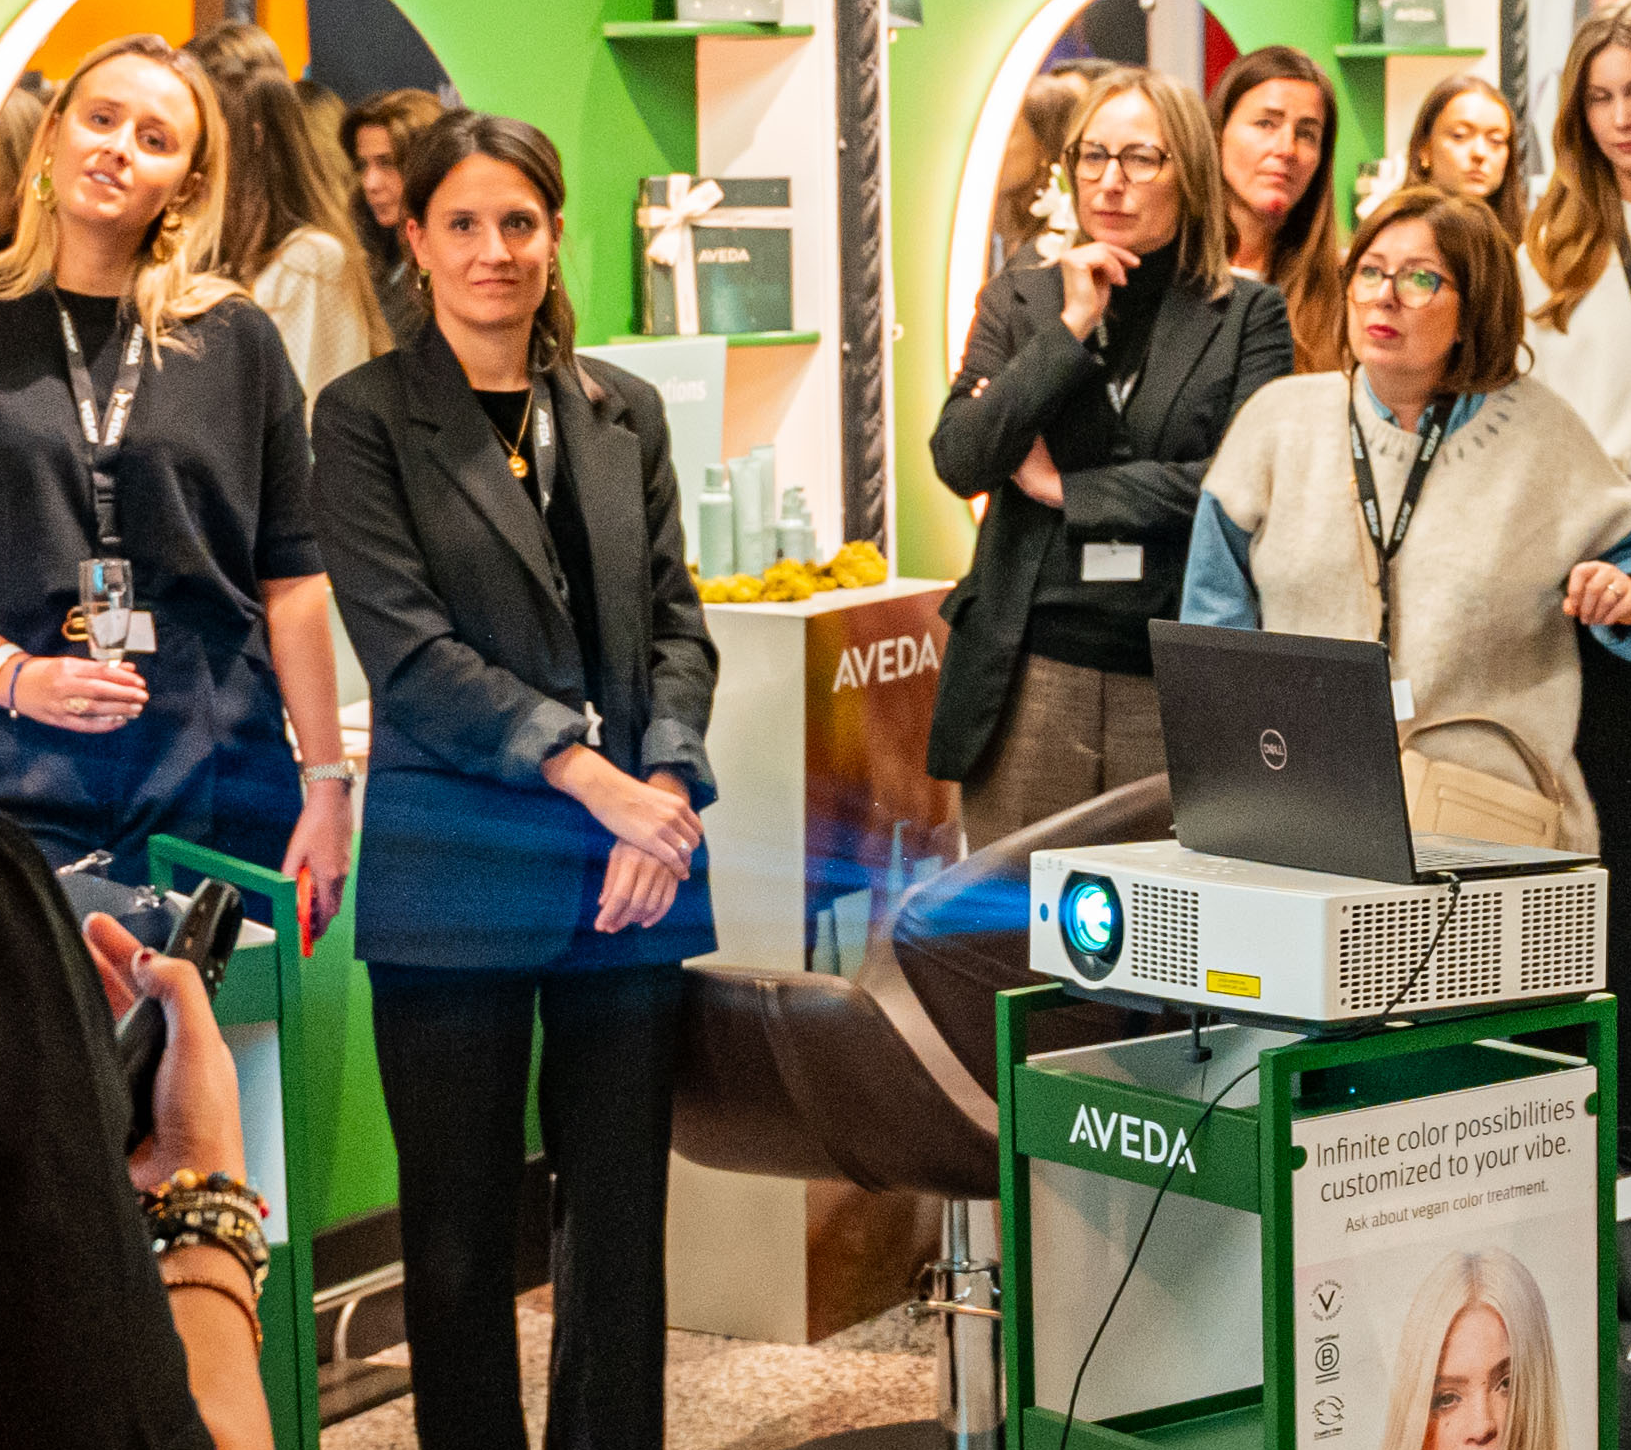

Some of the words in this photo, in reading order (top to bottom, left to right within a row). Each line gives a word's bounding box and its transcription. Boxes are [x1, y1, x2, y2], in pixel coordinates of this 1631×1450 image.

[698, 247, 750, 263] AVEDA
[832, 632, 939, 693] AVEDA
[1069, 1104, 1197, 1174] AVEDA
[1317, 1134, 1390, 1168] Infinite
[1397, 1122, 1449, 1152] color
[1456, 1098, 1575, 1147] possibilities
[1321, 1154, 1441, 1202] customized
[1448, 1156, 1468, 1177] to
[1474, 1144, 1519, 1178] your
[1524, 1132, 1572, 1161] vibe.
[1345, 1215, 1369, 1233] Ask
[1371, 1207, 1409, 1228] about
[1411, 1199, 1449, 1220] vegan
[1453, 1190, 1483, 1210] color
[1486, 1179, 1549, 1204] treatment.
